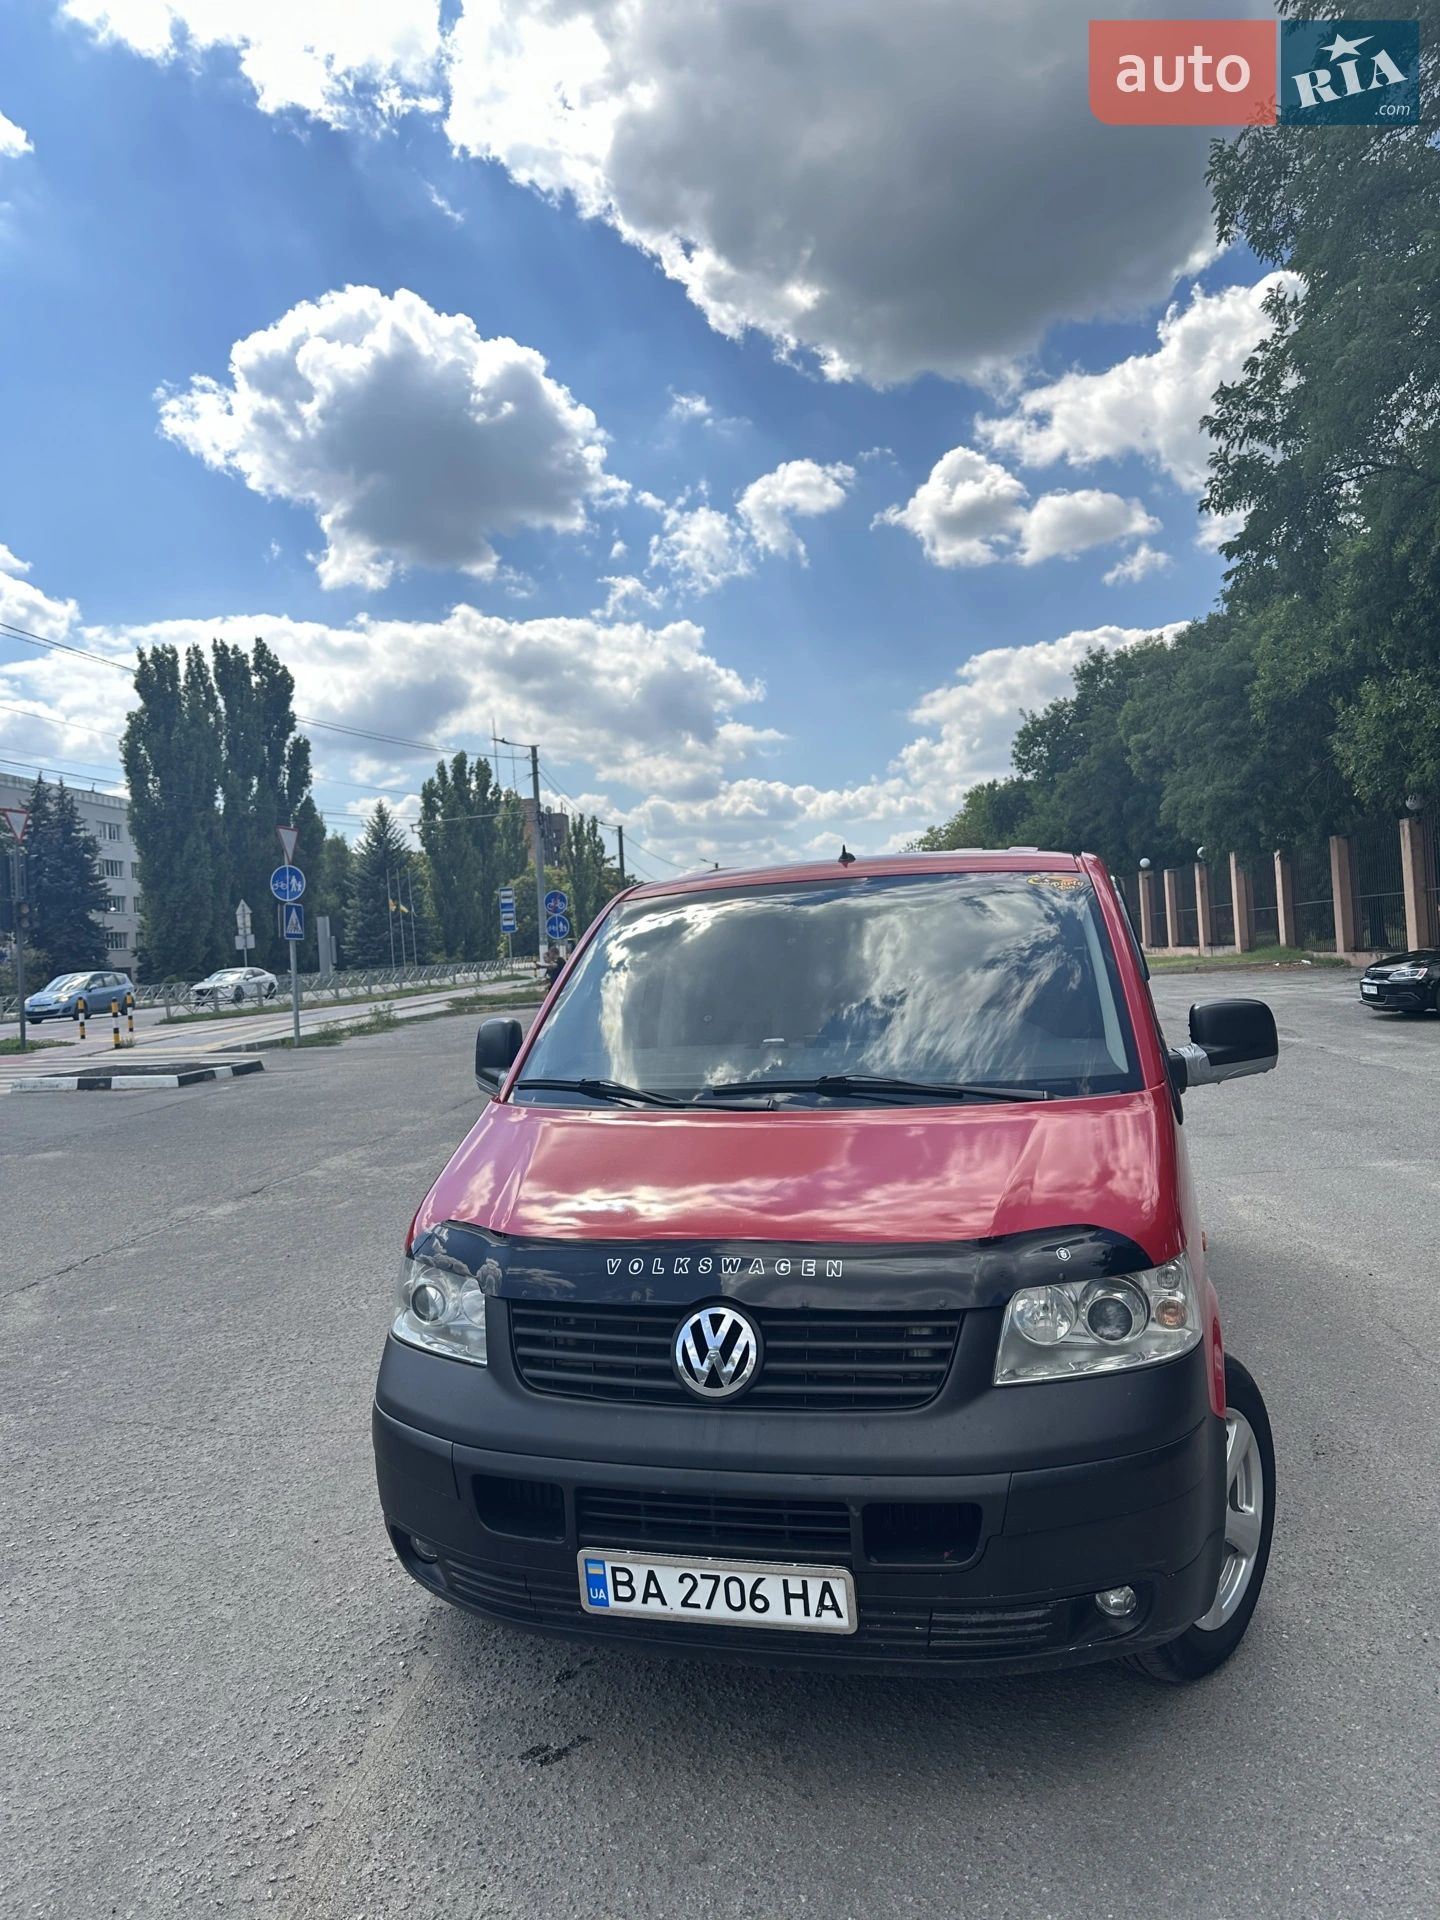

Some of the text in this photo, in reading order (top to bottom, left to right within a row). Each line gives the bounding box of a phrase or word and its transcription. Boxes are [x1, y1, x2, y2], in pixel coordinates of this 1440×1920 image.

[607, 1258, 843, 1277] VOLKSWAGEN
[589, 1588, 607, 1600] UA
[610, 1566, 844, 1618] BA 2706 HA
